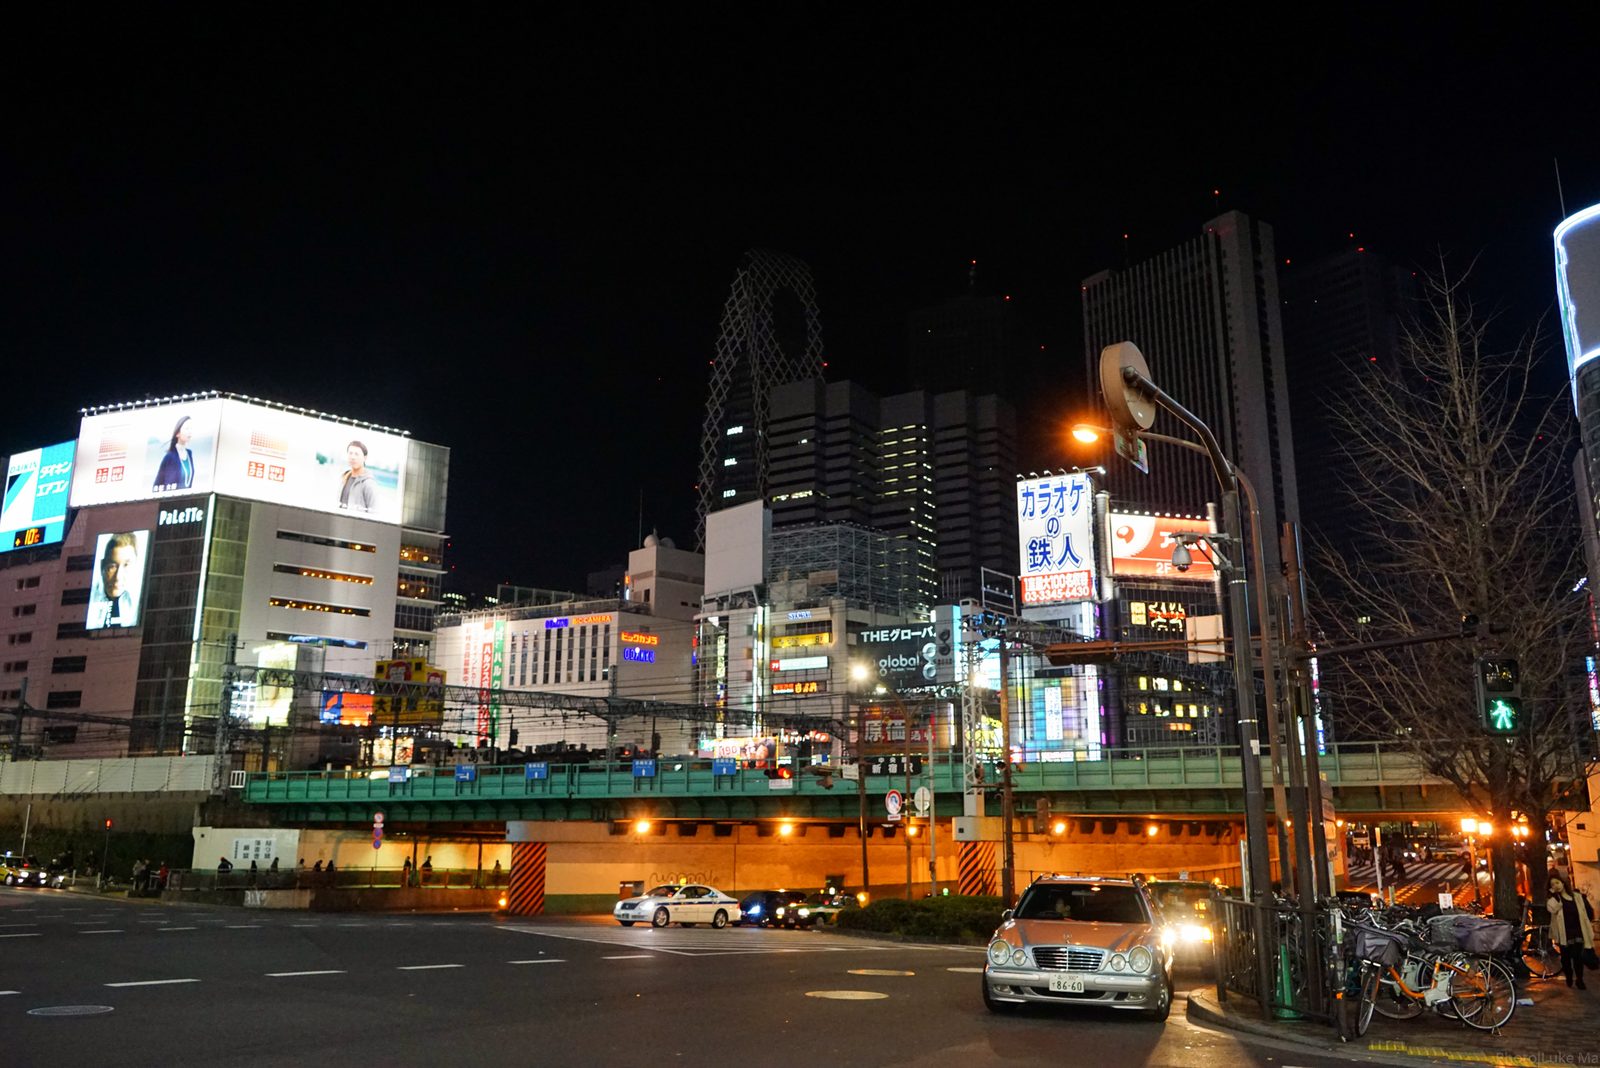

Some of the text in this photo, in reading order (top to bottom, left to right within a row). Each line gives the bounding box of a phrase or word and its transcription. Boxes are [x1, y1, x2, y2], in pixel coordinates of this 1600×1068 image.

[39, 461, 73, 478] ダイキン
[1022, 479, 1084, 517] カラオケ
[1047, 516, 1060, 534] の
[1028, 536, 1080, 568] 鉄人
[1156, 562, 1172, 574] 2F
[879, 654, 920, 676] global
[1056, 981, 1082, 991] 86-60
